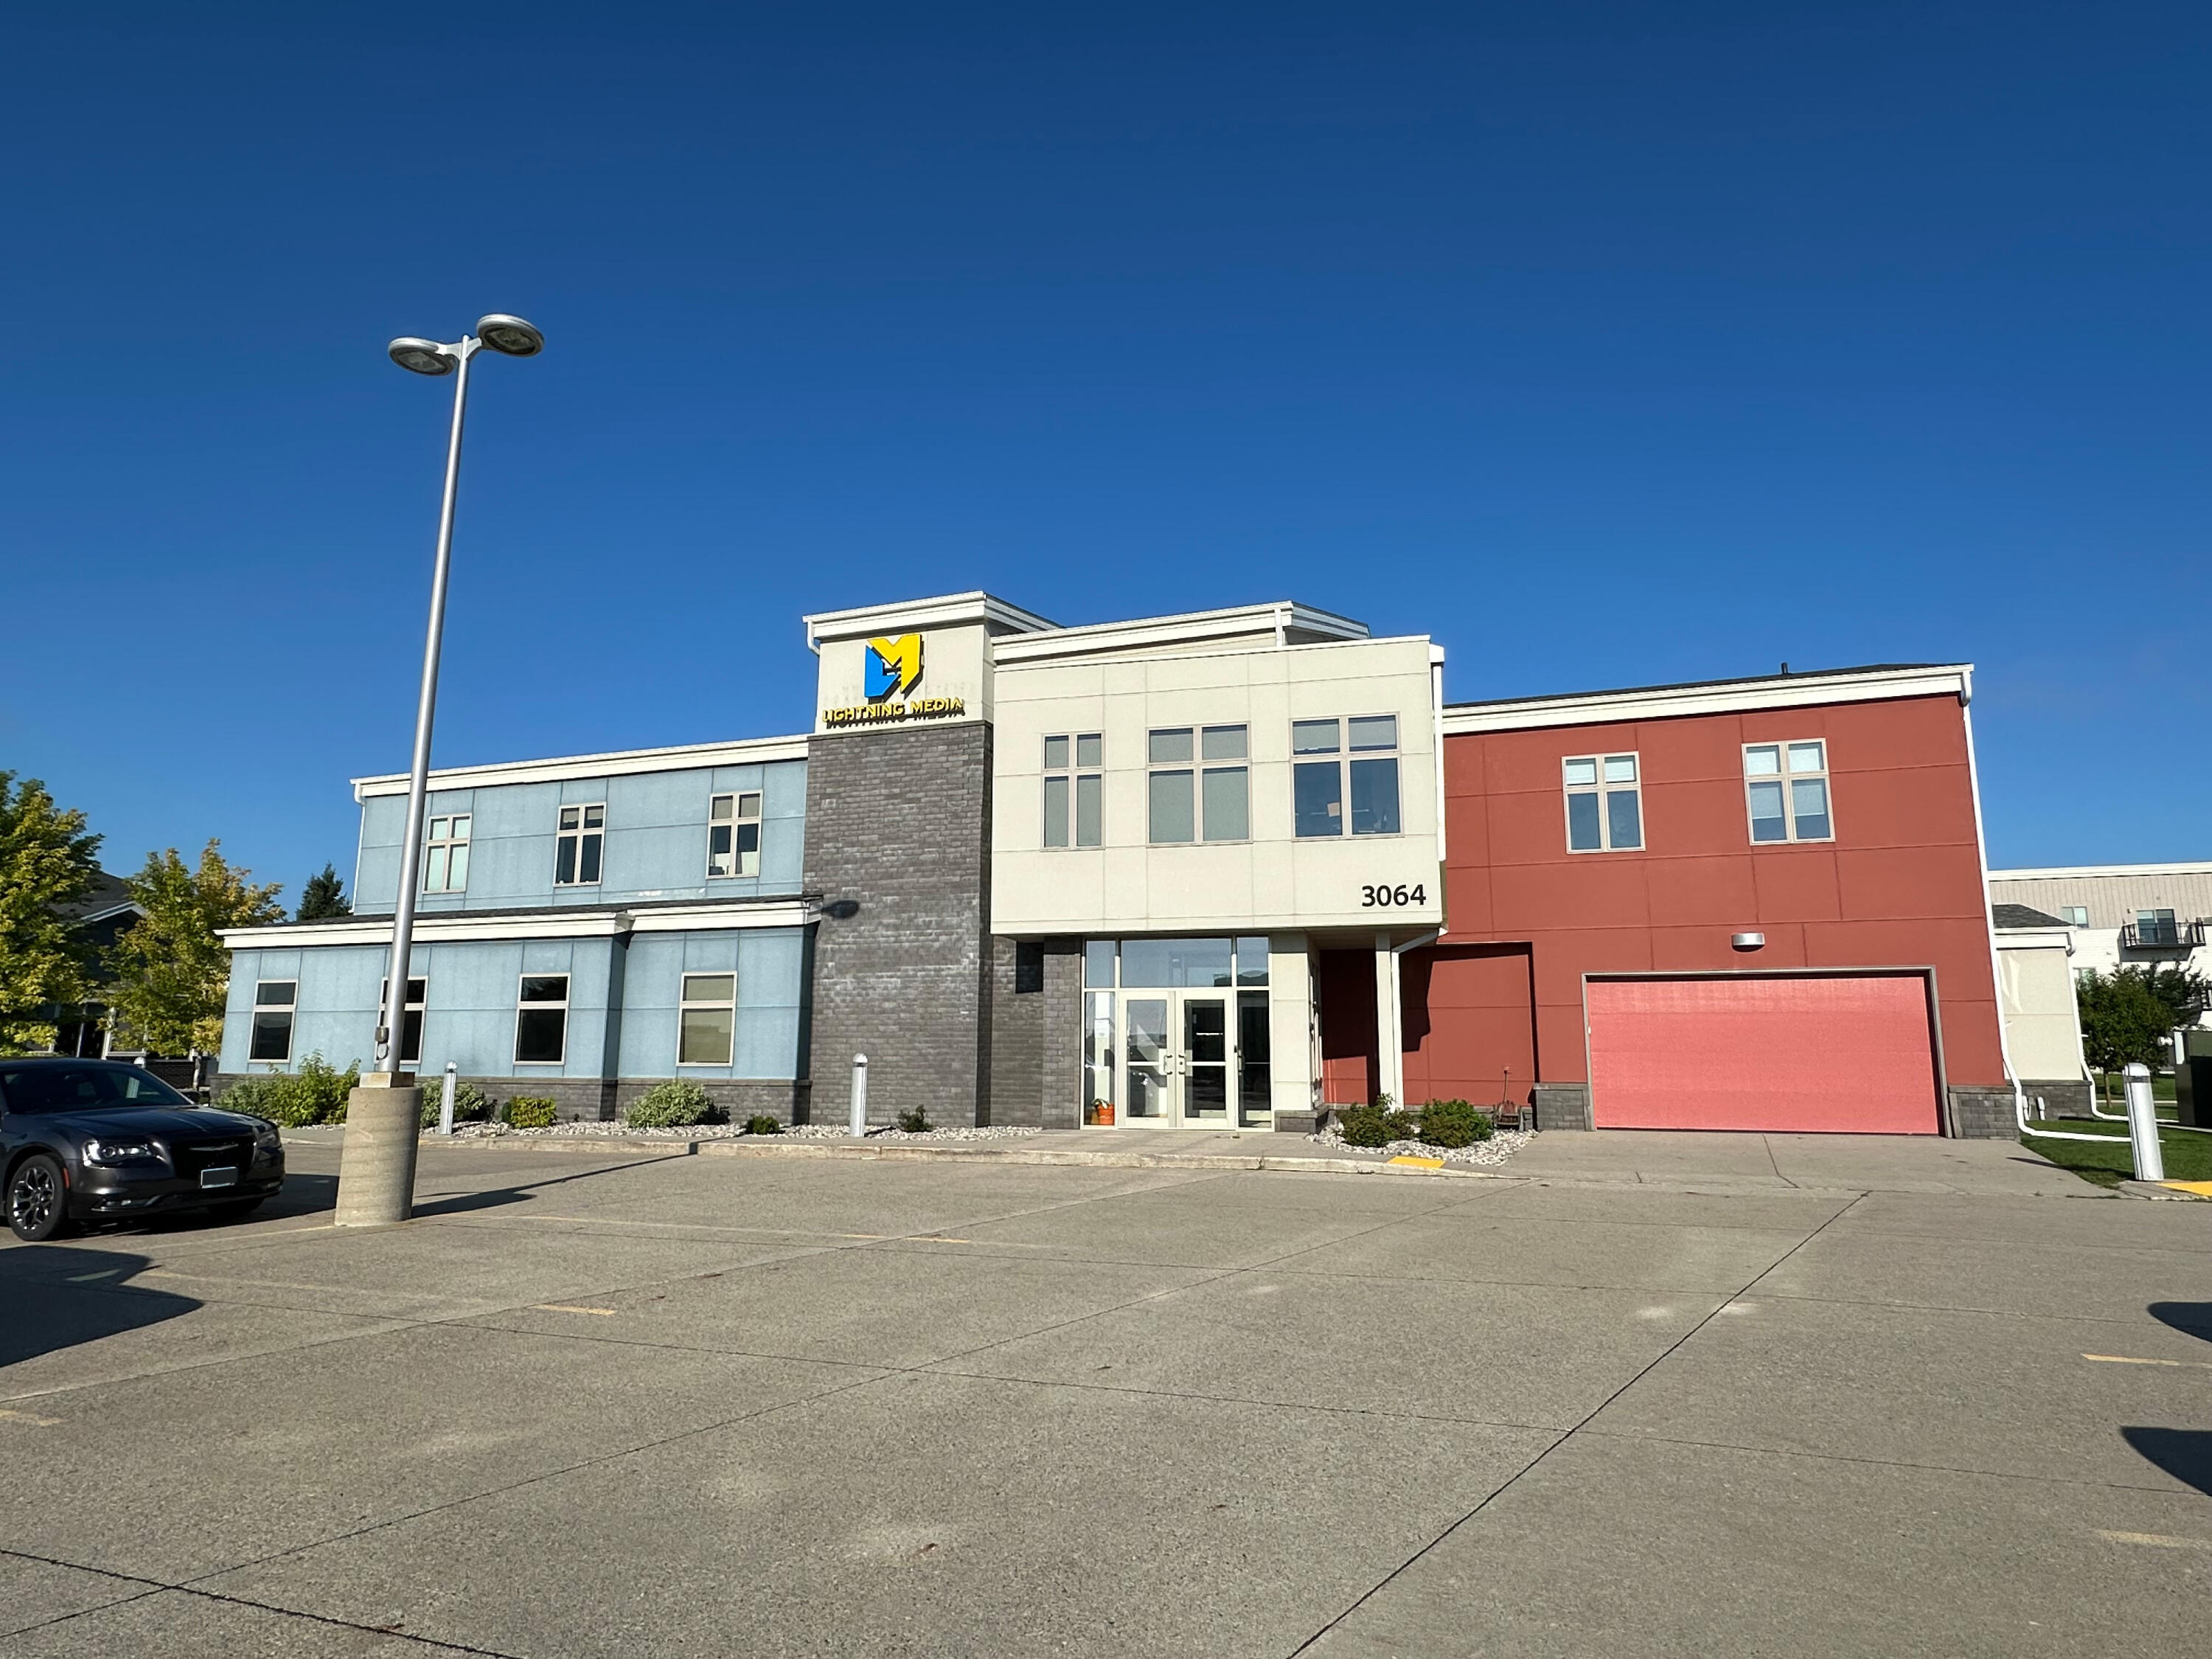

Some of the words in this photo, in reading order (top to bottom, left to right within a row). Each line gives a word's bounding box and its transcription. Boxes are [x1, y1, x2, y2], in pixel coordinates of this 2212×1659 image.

[822, 702, 905, 723] LIGHTNING
[910, 697, 964, 714] MEDIA
[1361, 884, 1427, 907] 3064
